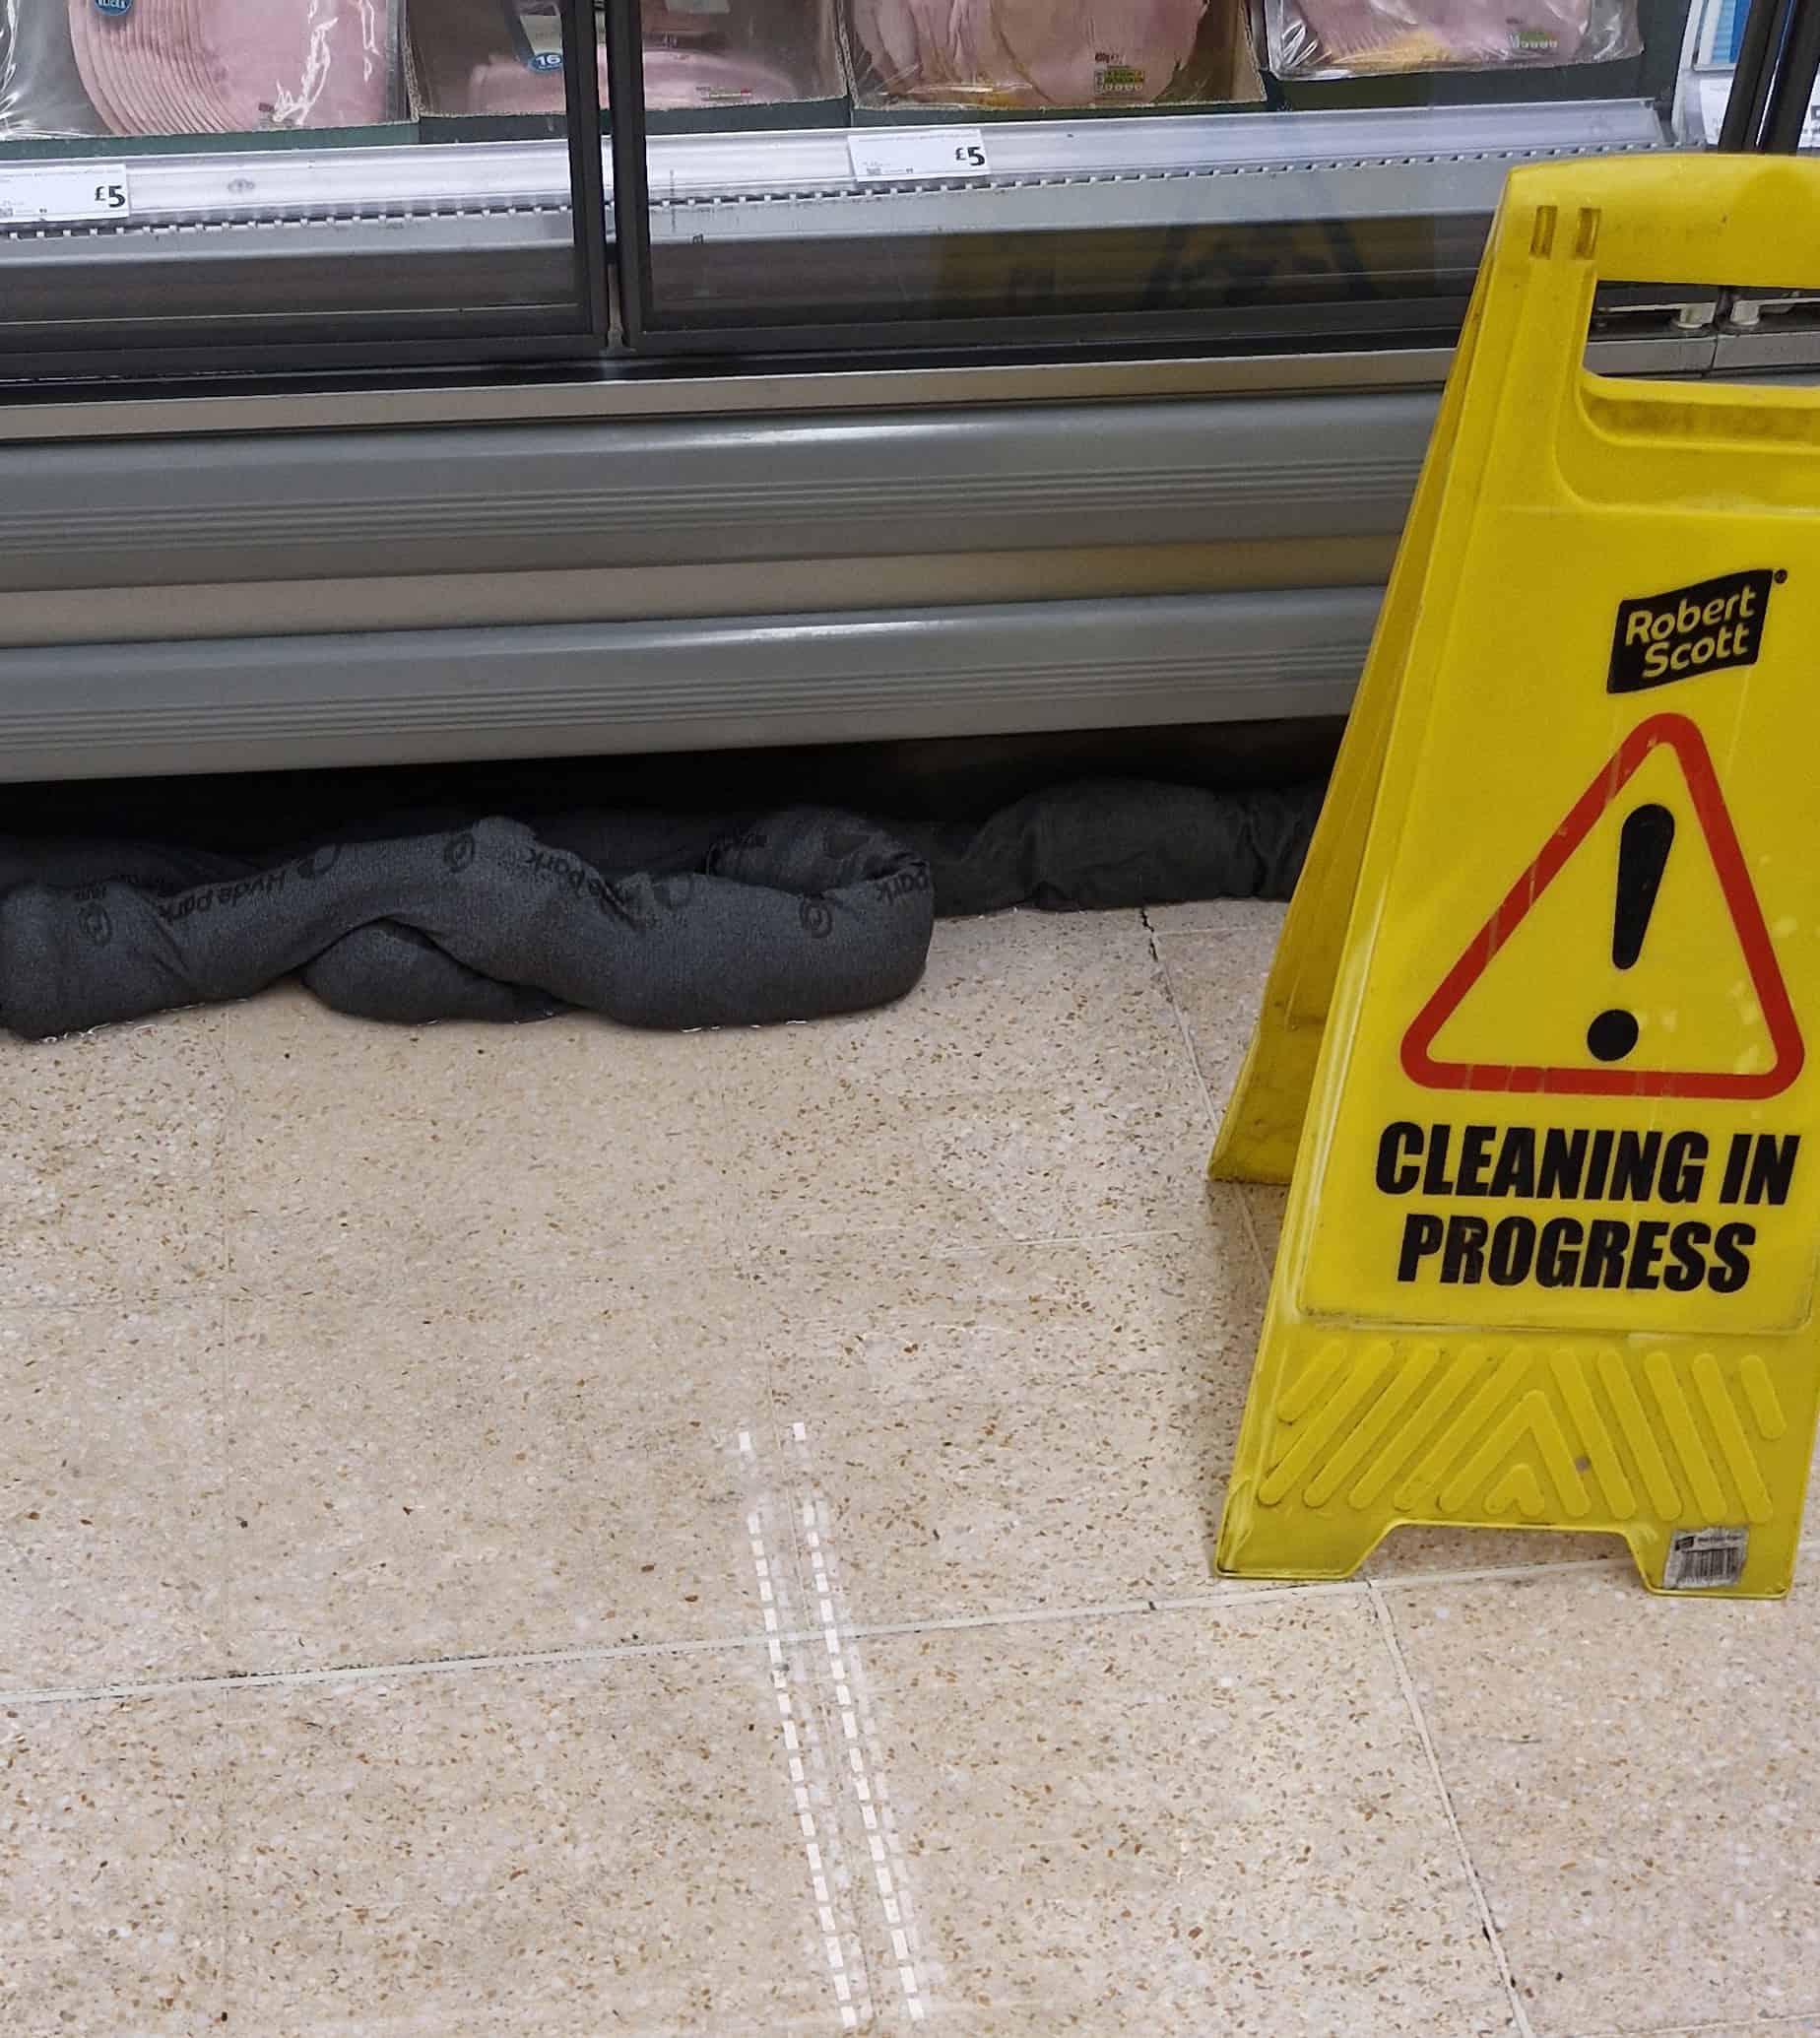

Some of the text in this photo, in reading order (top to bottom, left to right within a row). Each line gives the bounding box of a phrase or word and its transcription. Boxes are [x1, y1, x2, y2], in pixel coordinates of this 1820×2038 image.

[535, 54, 562, 65] 16
[955, 146, 986, 166] £5
[95, 184, 126, 208] £5
[1625, 585, 1757, 646] Robert
[1643, 623, 1750, 678] Scott
[1376, 1121, 1801, 1206] CLEANING IN
[1397, 1213, 1757, 1293] PROGRESS
